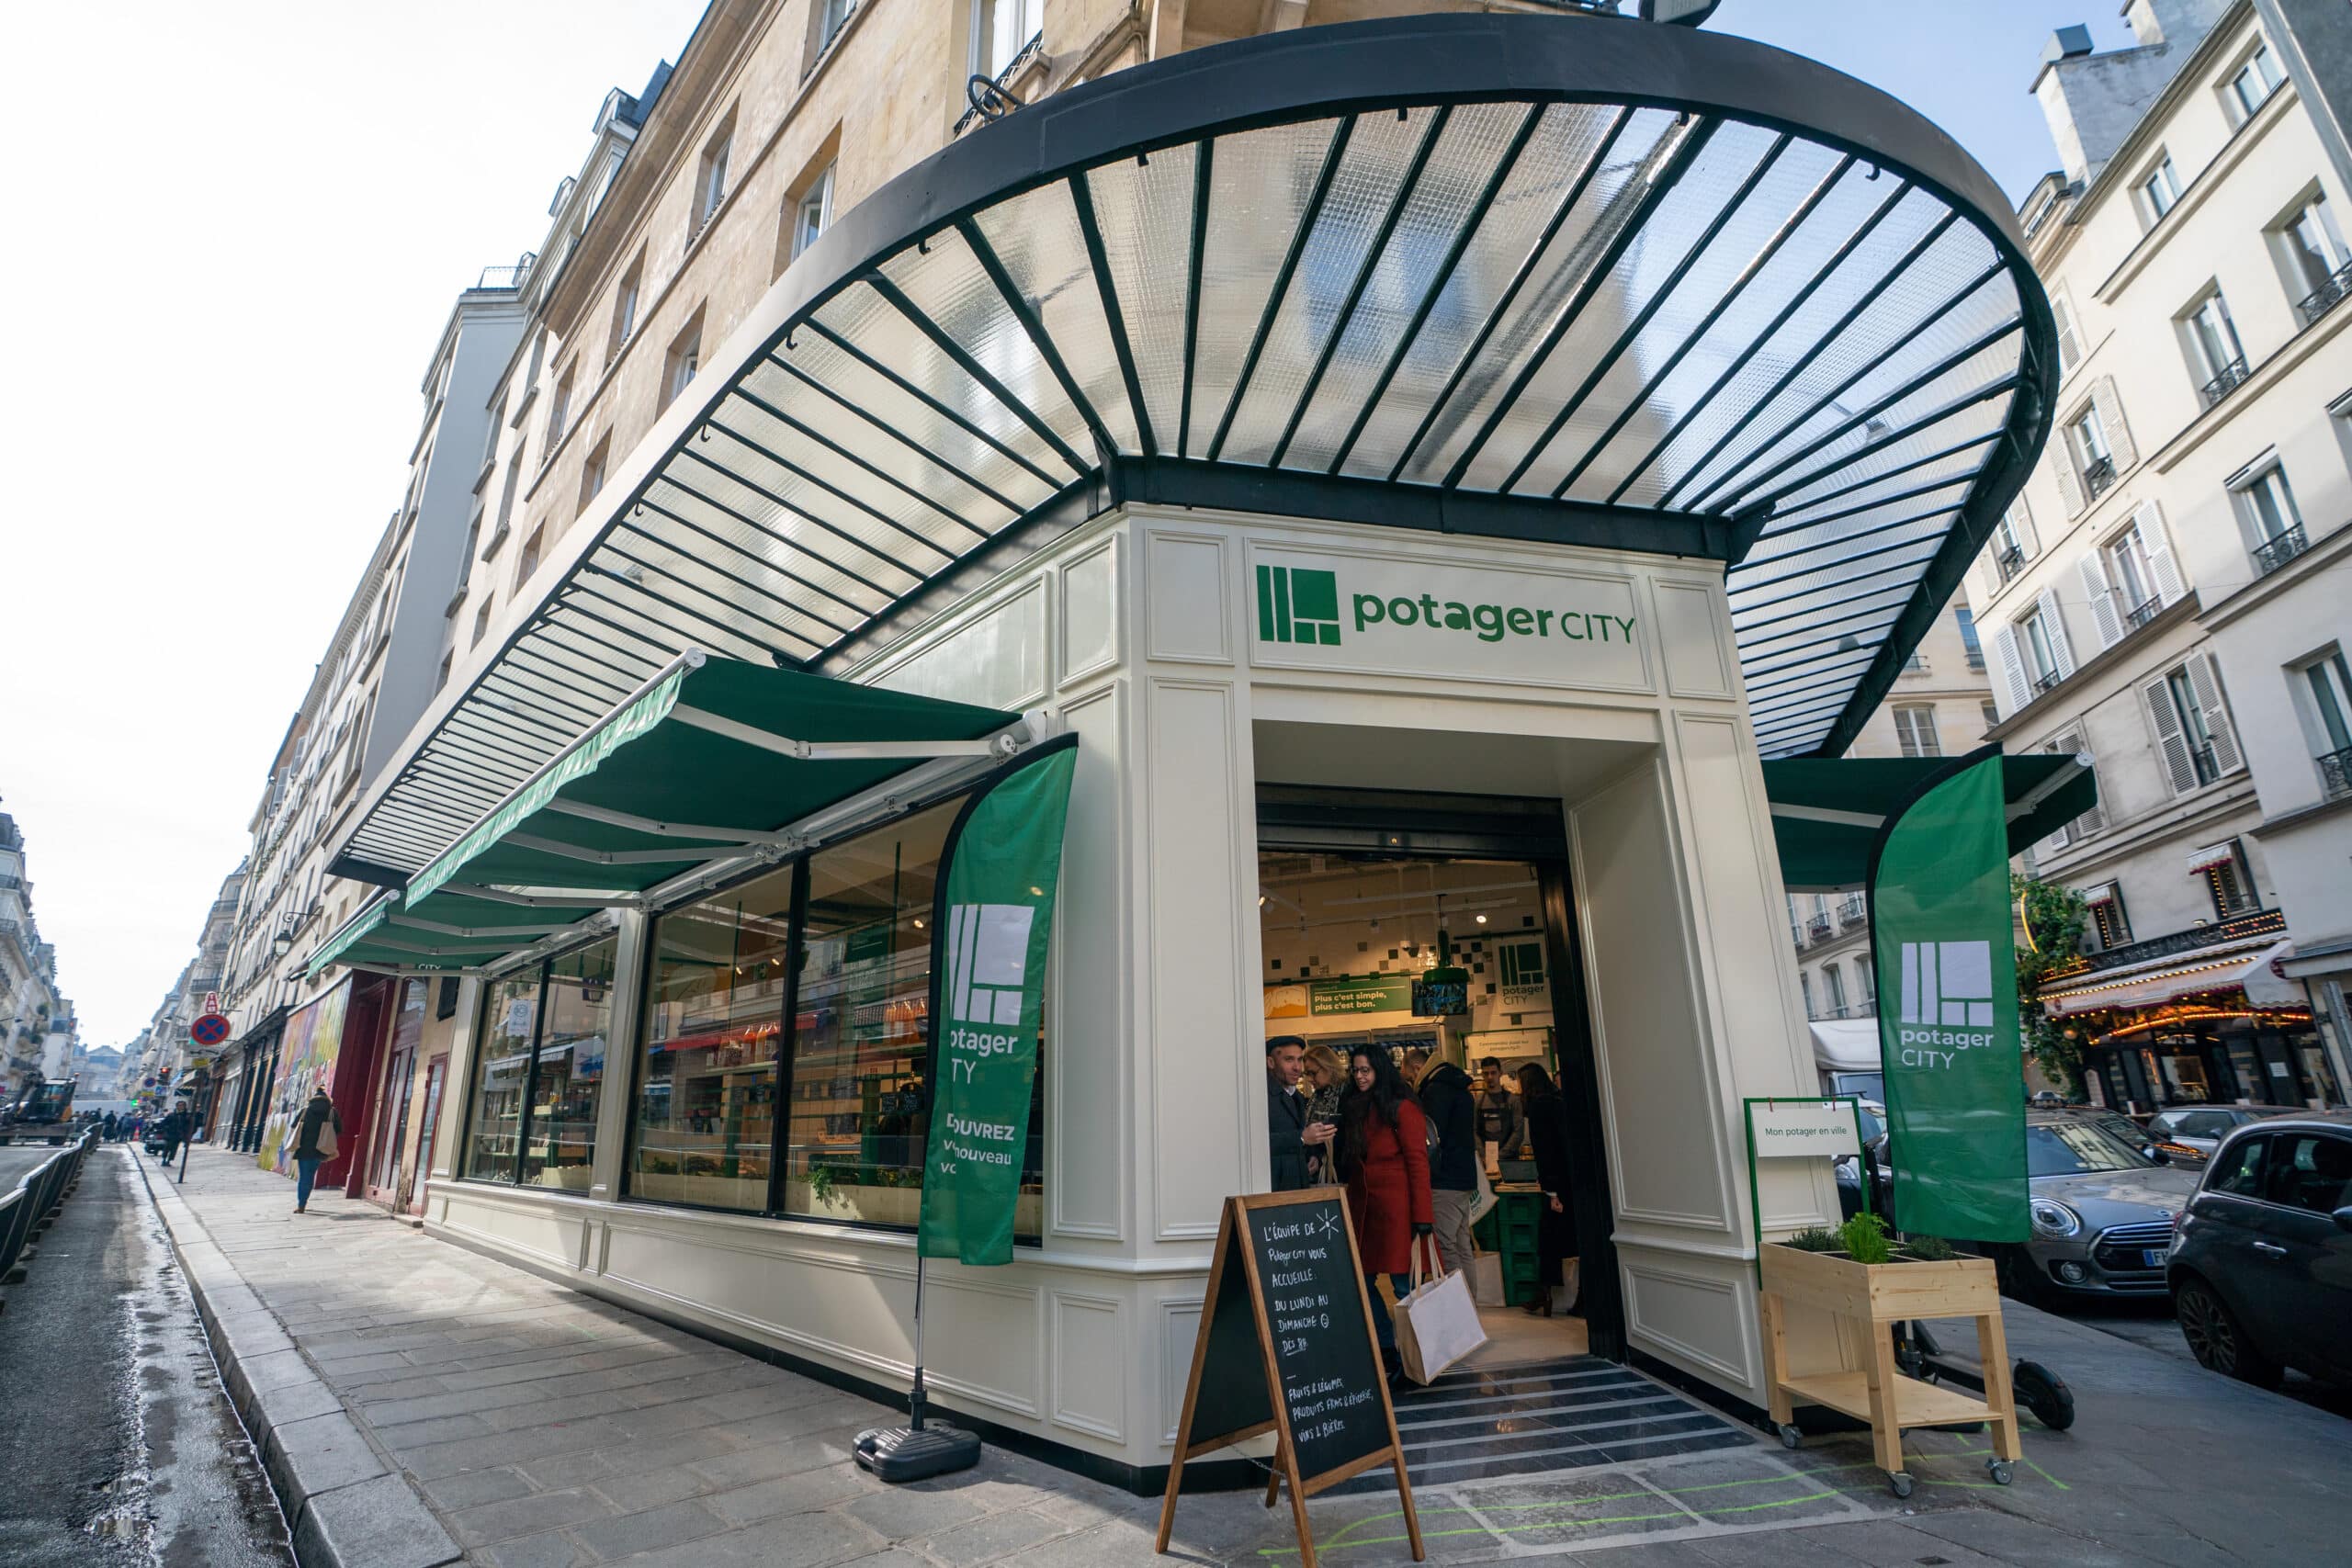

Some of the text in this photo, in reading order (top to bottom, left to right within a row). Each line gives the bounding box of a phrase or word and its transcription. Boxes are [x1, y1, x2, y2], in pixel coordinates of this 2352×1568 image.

[1352, 592, 1635, 644] potager CITY
[1315, 995, 1332, 1003] Plus
[1355, 991, 1386, 1000] simple,
[1502, 986, 1544, 997] potager
[1315, 1003, 1332, 1012] plus
[1503, 996, 1528, 1006] CITY
[950, 1028, 1018, 1056] otager
[1900, 1029, 1994, 1050] potager
[1901, 1049, 1955, 1069] CITY
[1765, 1128, 1783, 1136] Mon
[1785, 1128, 1816, 1137] potager
[1831, 1126, 1847, 1134] ville
[1305, 1222, 1316, 1235] DE
[1308, 1247, 1328, 1260] VOUS
[1275, 1300, 1287, 1312] DU
[1317, 1293, 1329, 1306] AU
